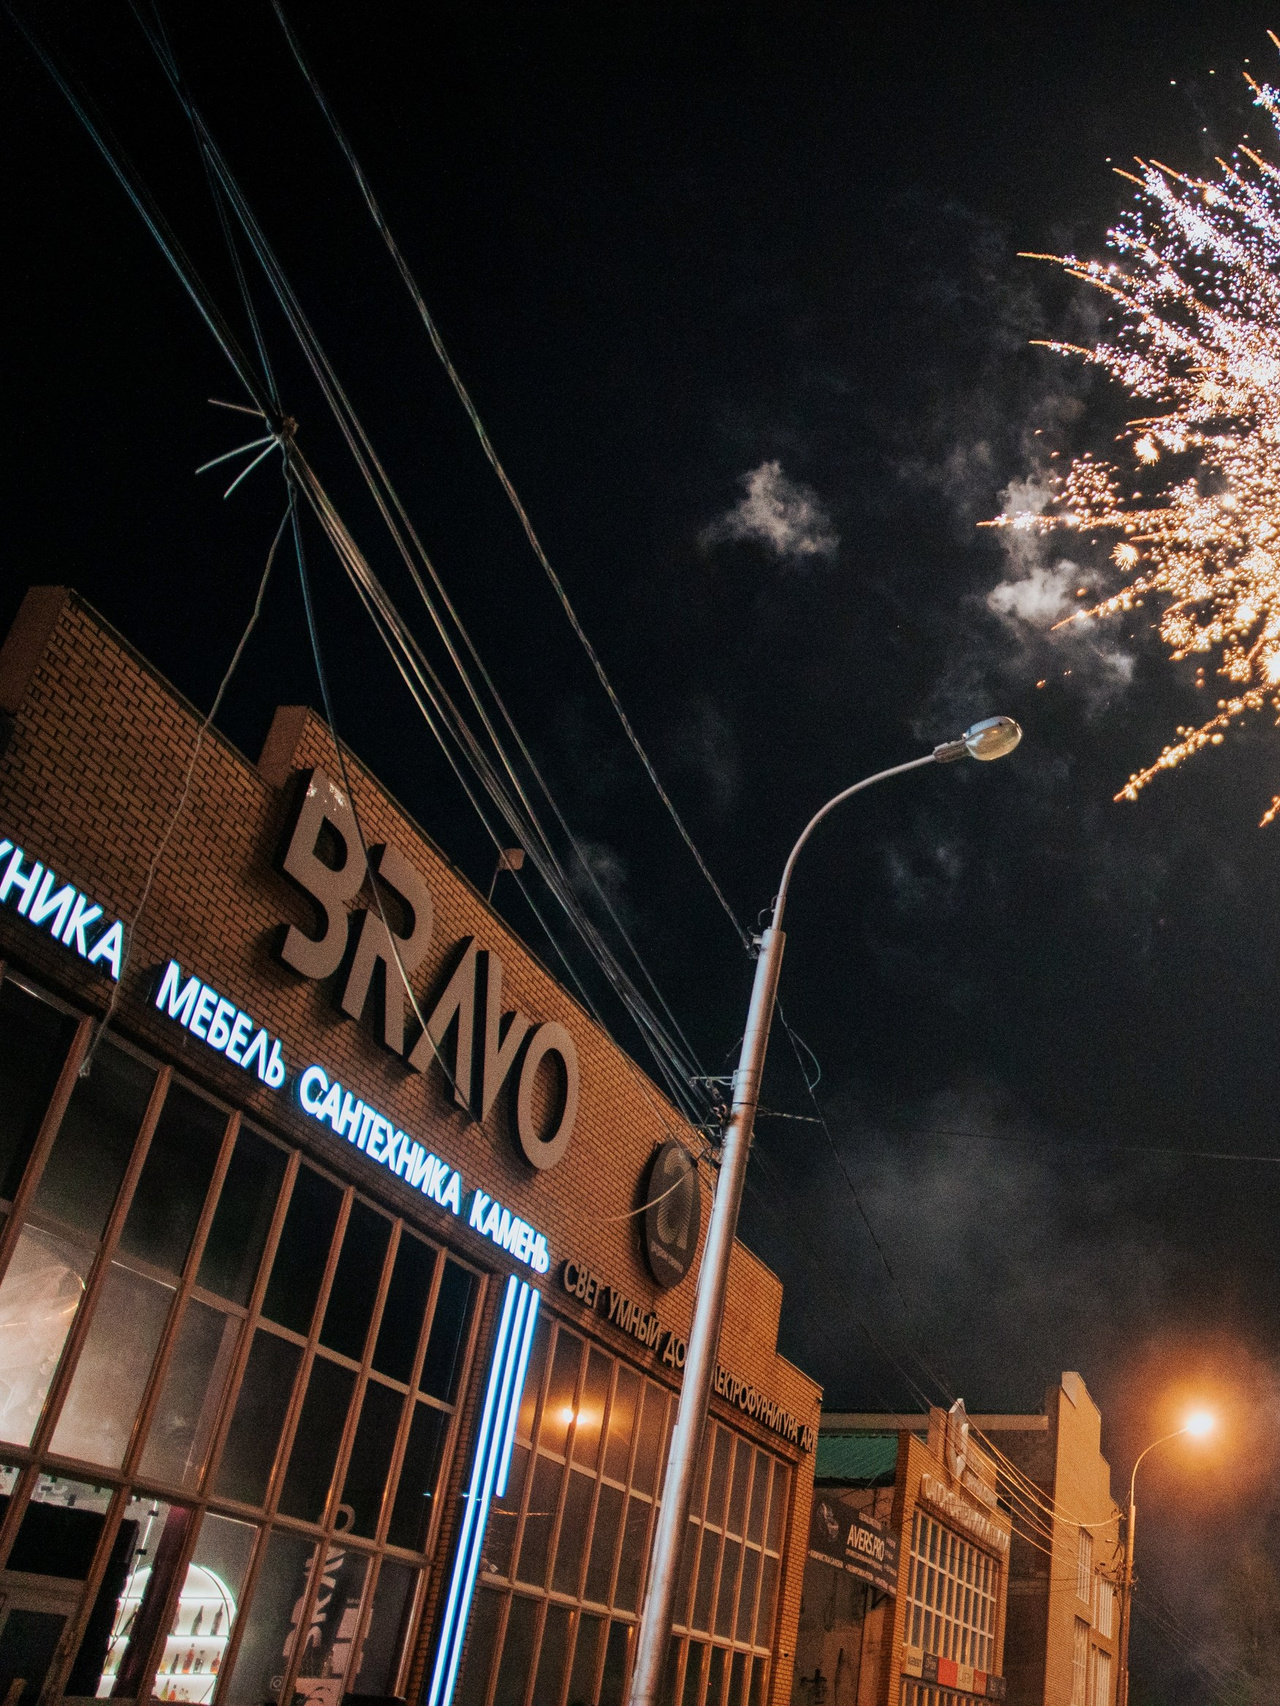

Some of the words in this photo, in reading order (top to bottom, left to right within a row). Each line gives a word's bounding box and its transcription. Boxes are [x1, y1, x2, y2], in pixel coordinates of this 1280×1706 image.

[0, 838, 123, 982] НИКА
[155, 960, 286, 1090] МЕБЕЛЬ
[299, 1065, 463, 1216] САНТЕХНИКА
[469, 1189, 550, 1274] КАМЕНЬ
[280, 768, 580, 1170] BRAVO
[564, 1259, 604, 1310] СВЕТ
[608, 1287, 662, 1351] УМНЫЙ
[662, 1330, 688, 1369] ДО
[714, 1362, 799, 1444] ЕКТРОФУРНИТУРА
